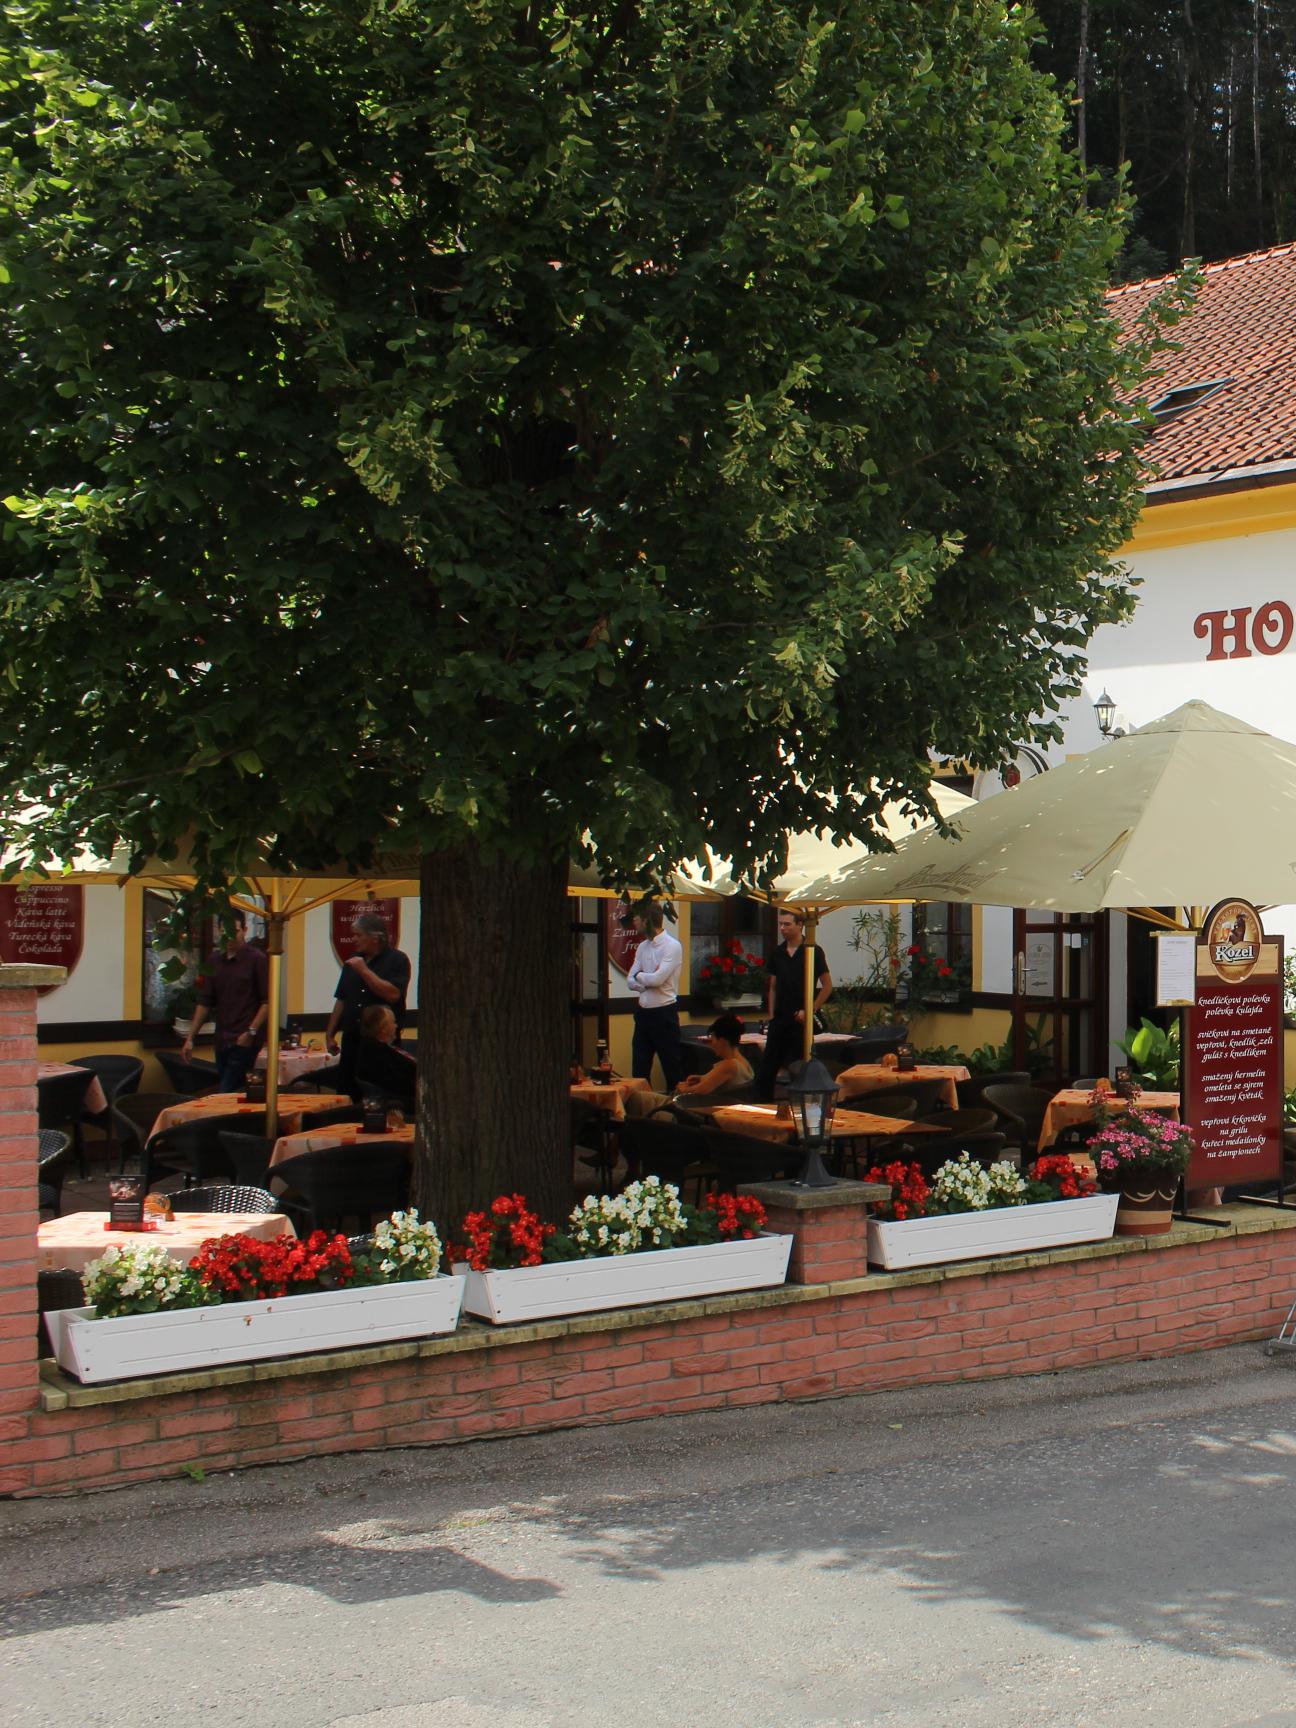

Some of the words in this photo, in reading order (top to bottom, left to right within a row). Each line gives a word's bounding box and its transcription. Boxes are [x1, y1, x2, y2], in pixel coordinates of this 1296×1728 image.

[1215, 945, 1255, 962] Kozel
[1242, 994, 1271, 1006] polévka
[1204, 1007, 1234, 1018] polévka
[1236, 1005, 1263, 1016] kulajda
[1204, 1083, 1232, 1092] omeleta
[1243, 1081, 1264, 1091] sýrem
[1229, 1125, 1248, 1137] grilu
[1225, 1134, 1266, 1145] medailonky
